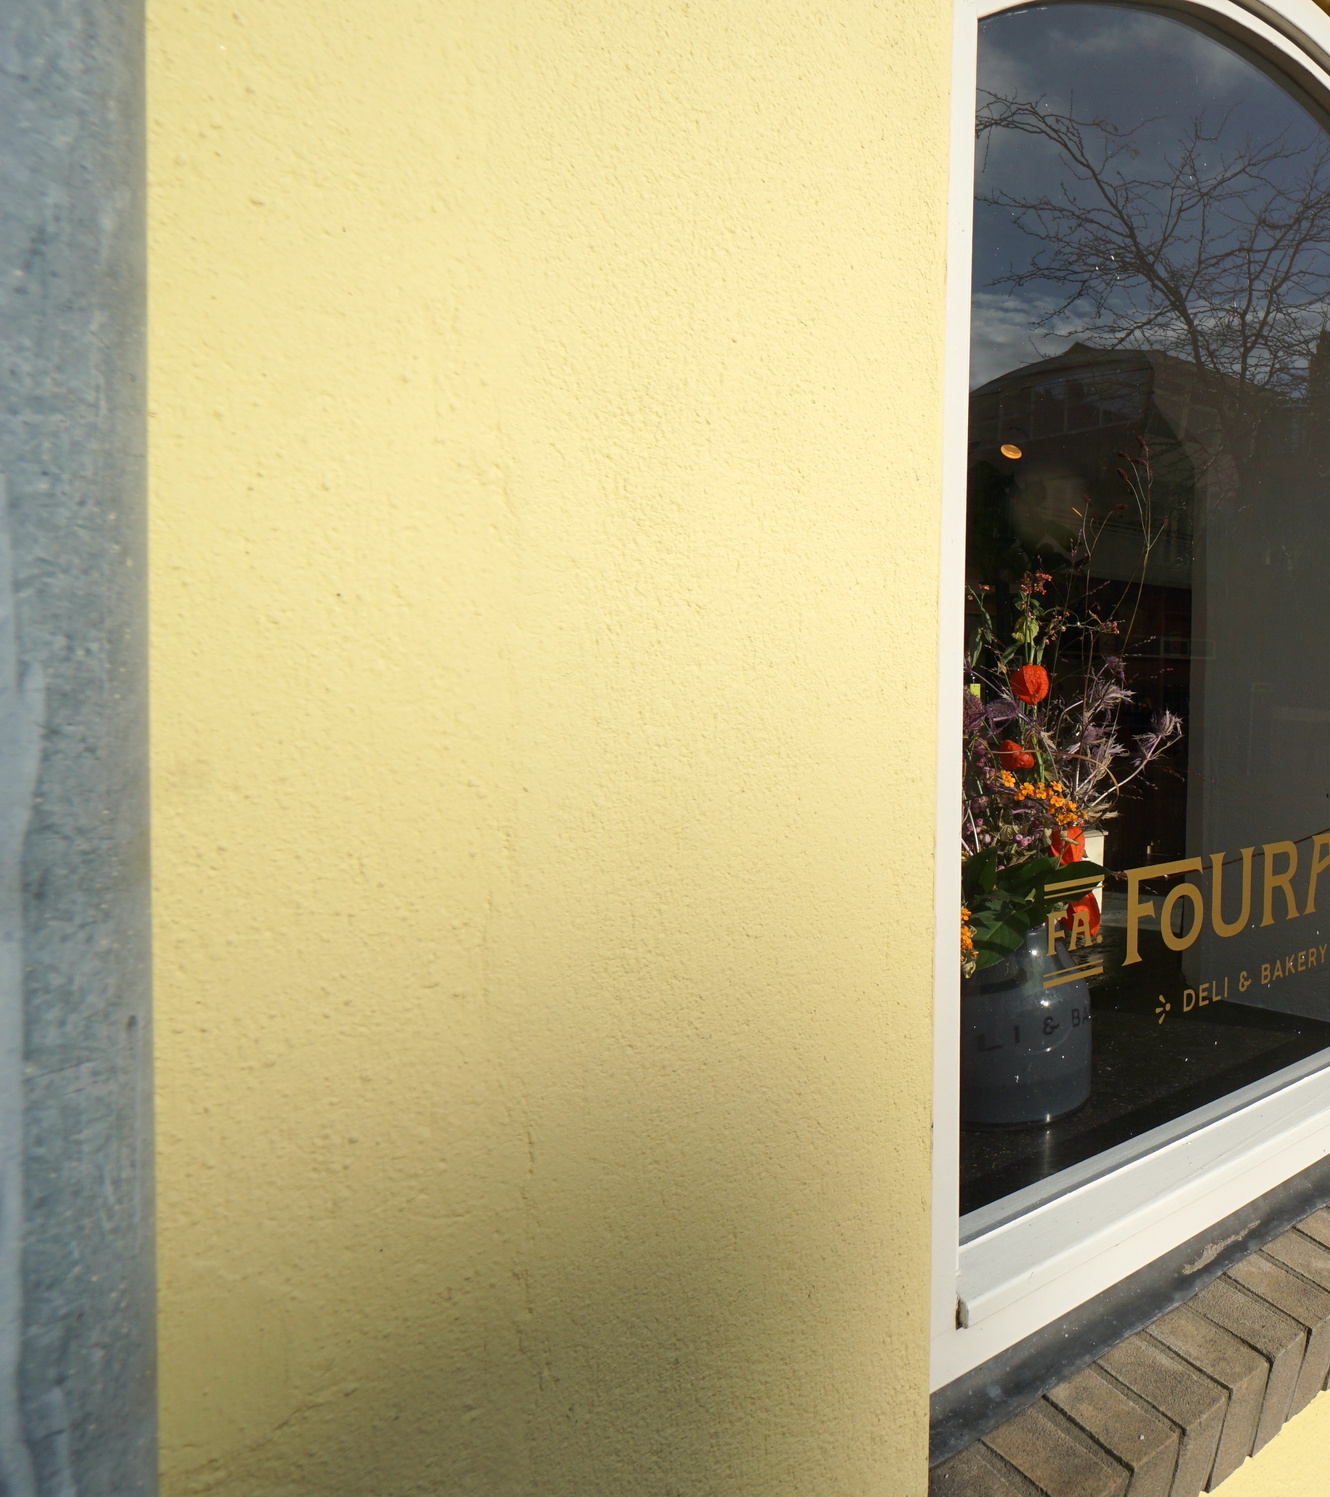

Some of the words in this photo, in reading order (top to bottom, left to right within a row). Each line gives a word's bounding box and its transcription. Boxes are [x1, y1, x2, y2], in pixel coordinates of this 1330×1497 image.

[1046, 910, 1102, 956] FA.
[1183, 976, 1228, 1012] DELI
[1238, 971, 1251, 992] &
[1261, 944, 1328, 985] BAKERY
